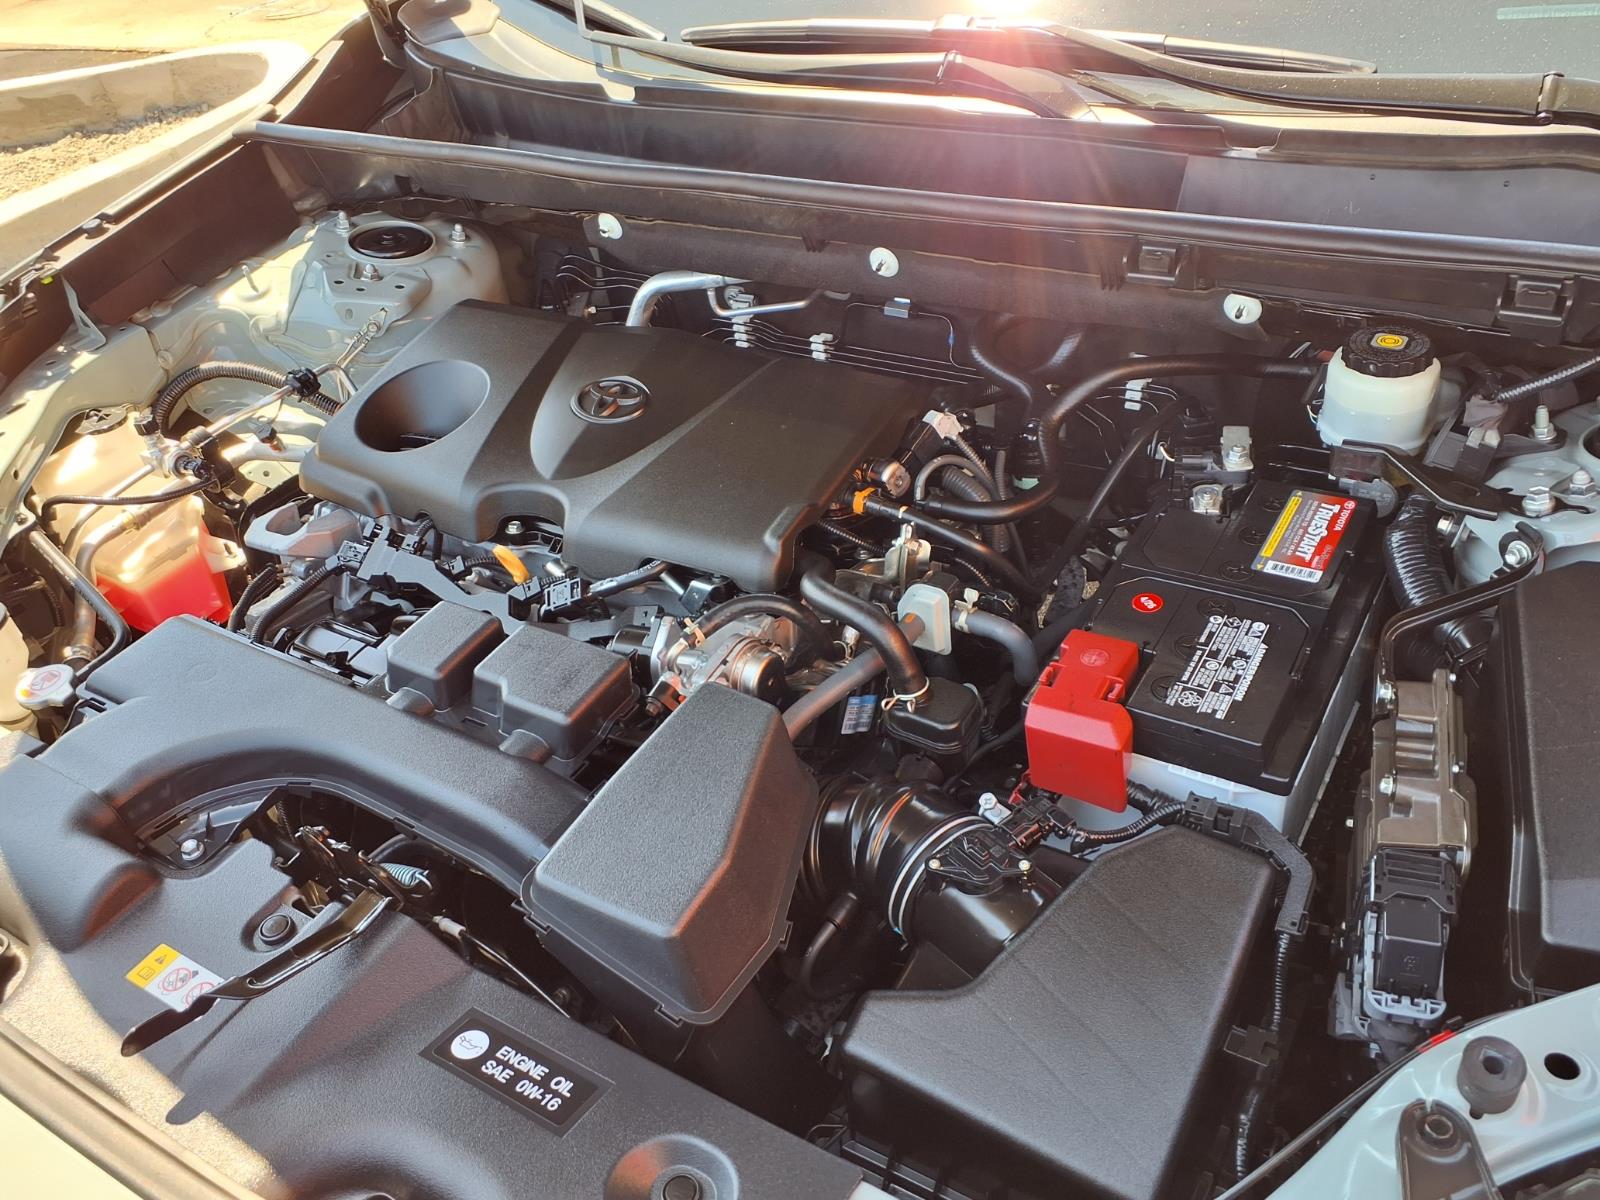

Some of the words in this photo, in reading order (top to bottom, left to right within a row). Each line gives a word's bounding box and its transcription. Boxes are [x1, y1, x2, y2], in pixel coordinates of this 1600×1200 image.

[1333, 510, 1350, 531] TOYOTA
[481, 1060, 514, 1083] SAE
[515, 1079, 562, 1111] 0W-16
[495, 1045, 549, 1080] ENGINE
[550, 1076, 575, 1097] OIL
